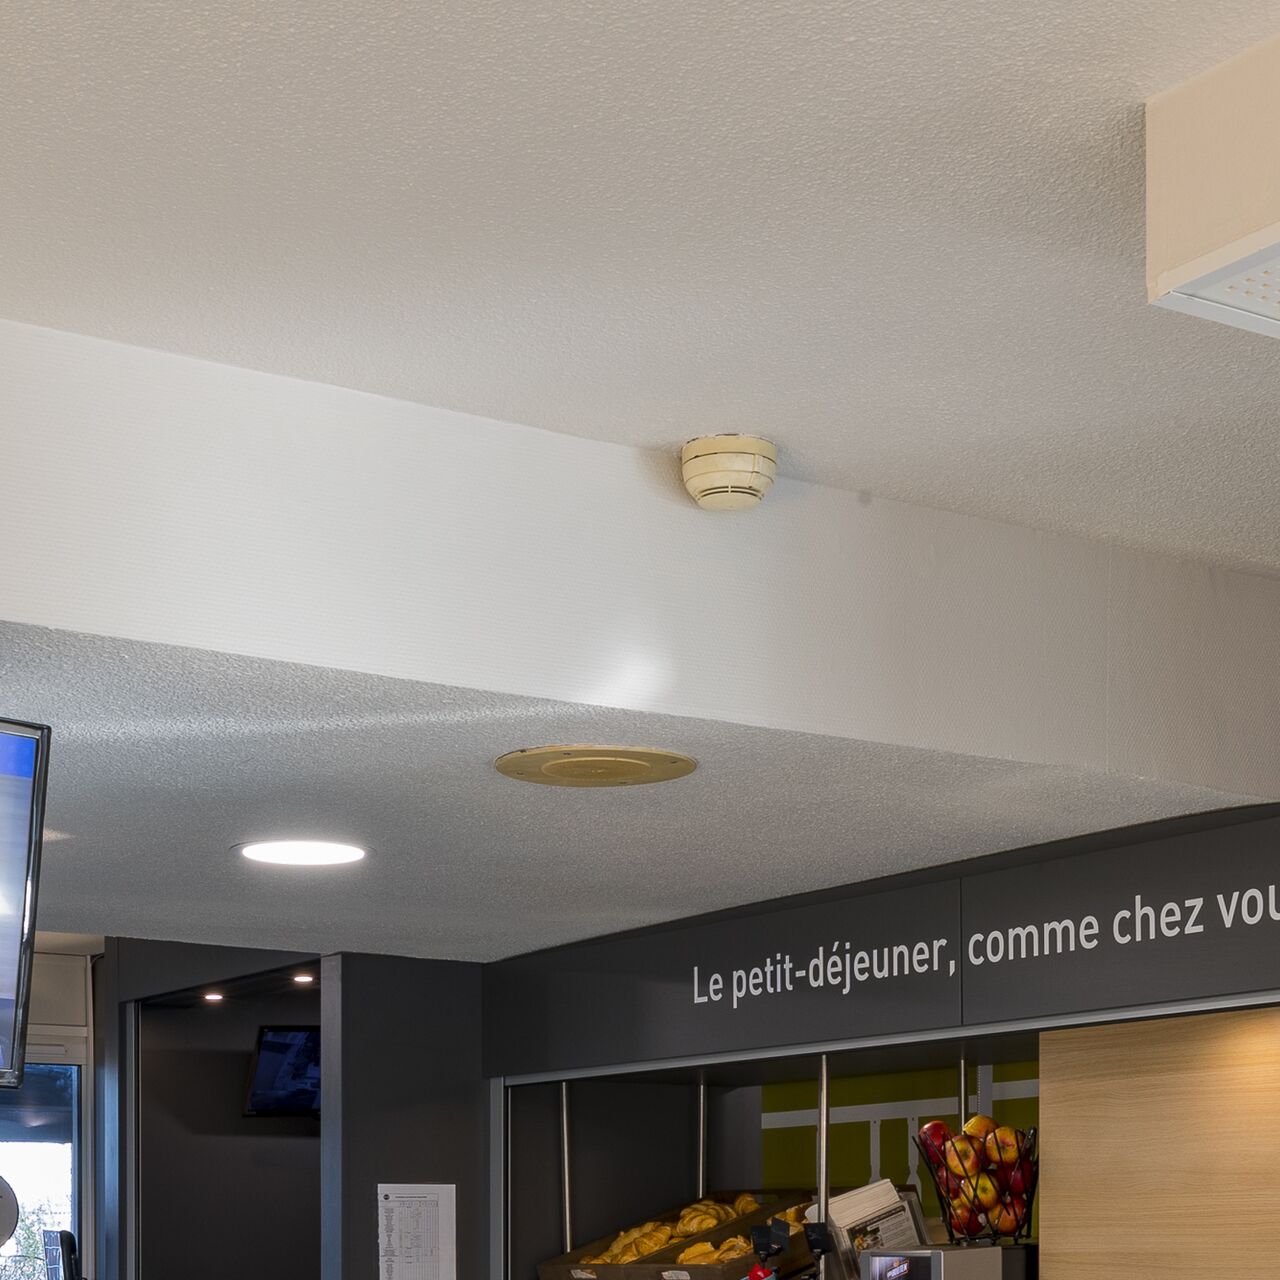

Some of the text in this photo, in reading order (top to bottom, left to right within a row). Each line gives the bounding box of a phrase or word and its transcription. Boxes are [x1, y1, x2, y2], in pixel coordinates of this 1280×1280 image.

[693, 966, 724, 1004] Le
[733, 936, 956, 1009] petit-déjeuner,
[968, 916, 1100, 967] comme
[1112, 894, 1205, 945] chez
